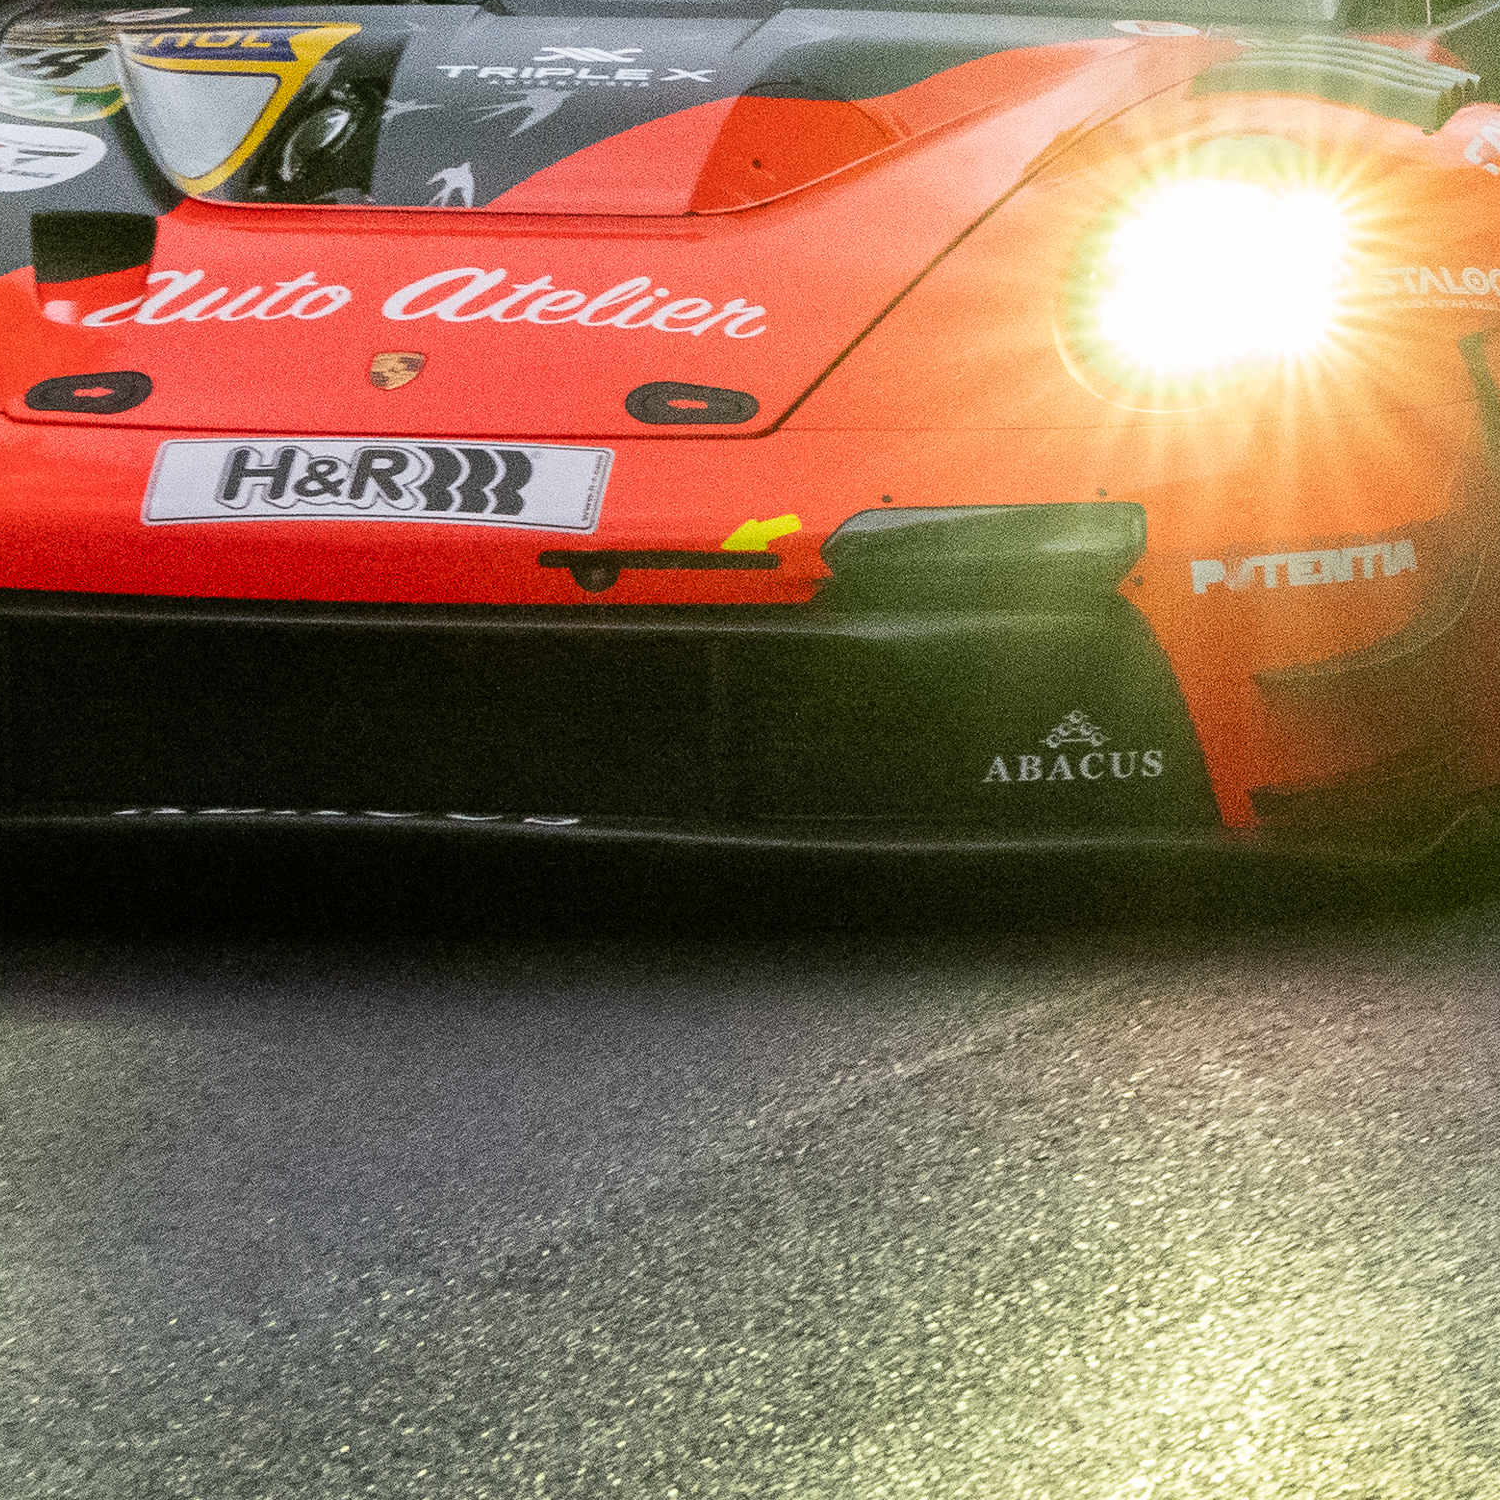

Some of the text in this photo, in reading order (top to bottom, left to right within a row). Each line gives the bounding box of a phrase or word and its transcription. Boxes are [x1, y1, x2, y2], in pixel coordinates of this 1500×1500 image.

[436, 64, 718, 82] TRIPLE X
[82, 266, 767, 340] Auto Atelier
[219, 444, 416, 510] H&R
[981, 749, 1165, 783] ABACUS
